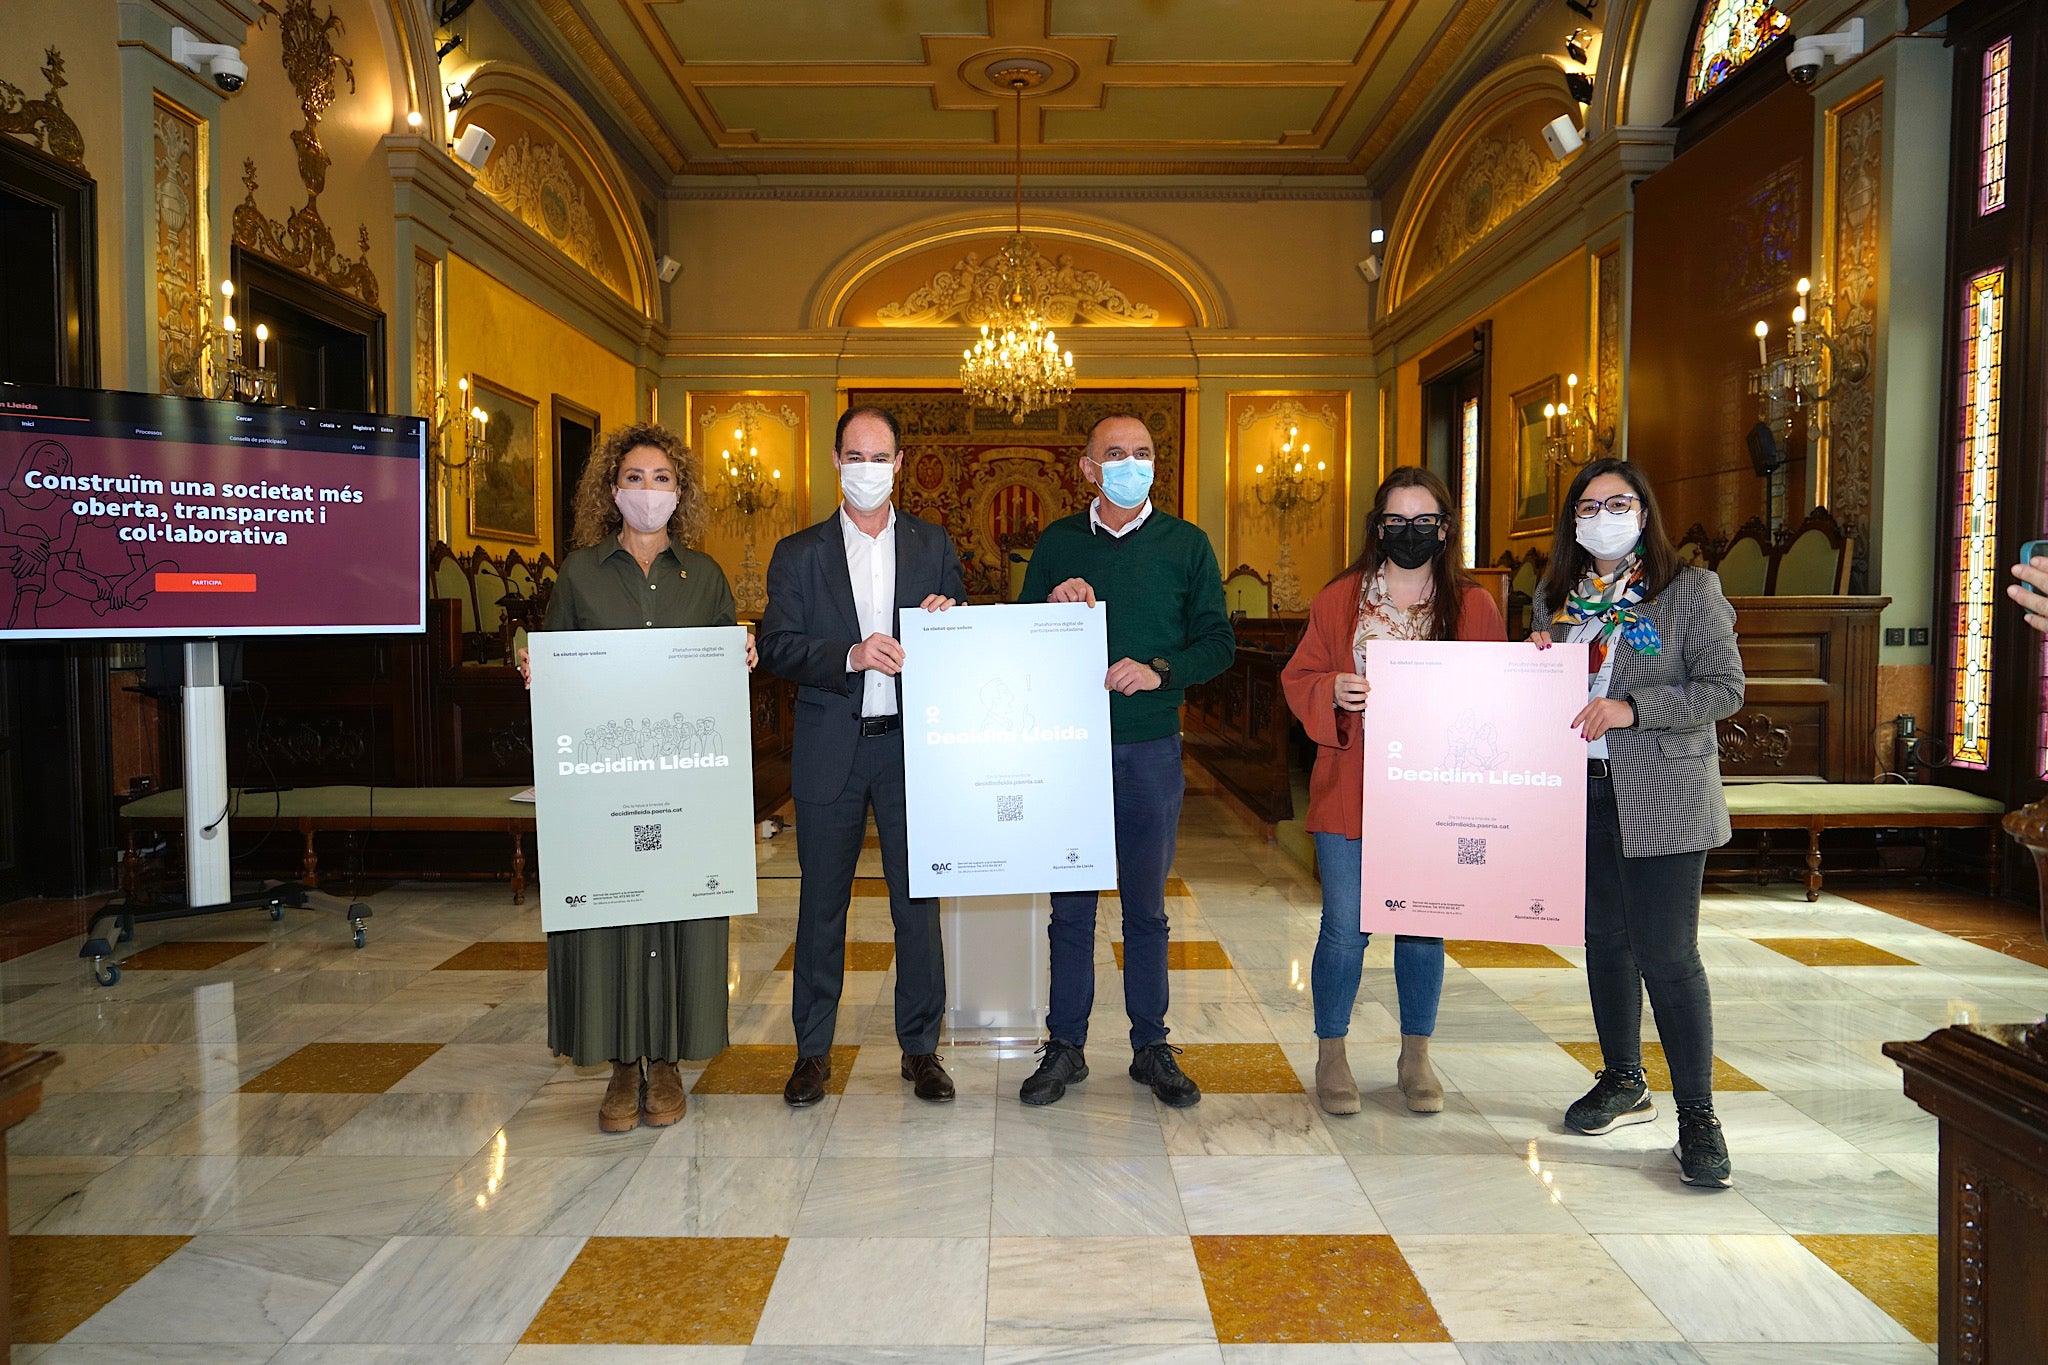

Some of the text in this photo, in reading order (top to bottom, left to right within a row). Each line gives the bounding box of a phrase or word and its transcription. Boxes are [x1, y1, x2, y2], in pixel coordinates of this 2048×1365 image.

[7, 402, 38, 410] Lleida
[258, 438, 287, 446] participació
[25, 470, 364, 503] Construïm una societat més
[72, 497, 326, 525] oberta, transparent i
[119, 524, 288, 545] col·laborativa
[926, 725, 1089, 745] Decidim Lleida
[558, 752, 729, 776] Decidim Lleida
[1387, 766, 1563, 787] Decidim Lleida
[610, 807, 683, 817] decidimlleida.paeria.cat
[1435, 820, 1509, 830] decidimlleida.paeria.cat
[931, 863, 952, 871] OAC
[565, 895, 587, 904] OAC
[1385, 899, 1406, 908] OAC
